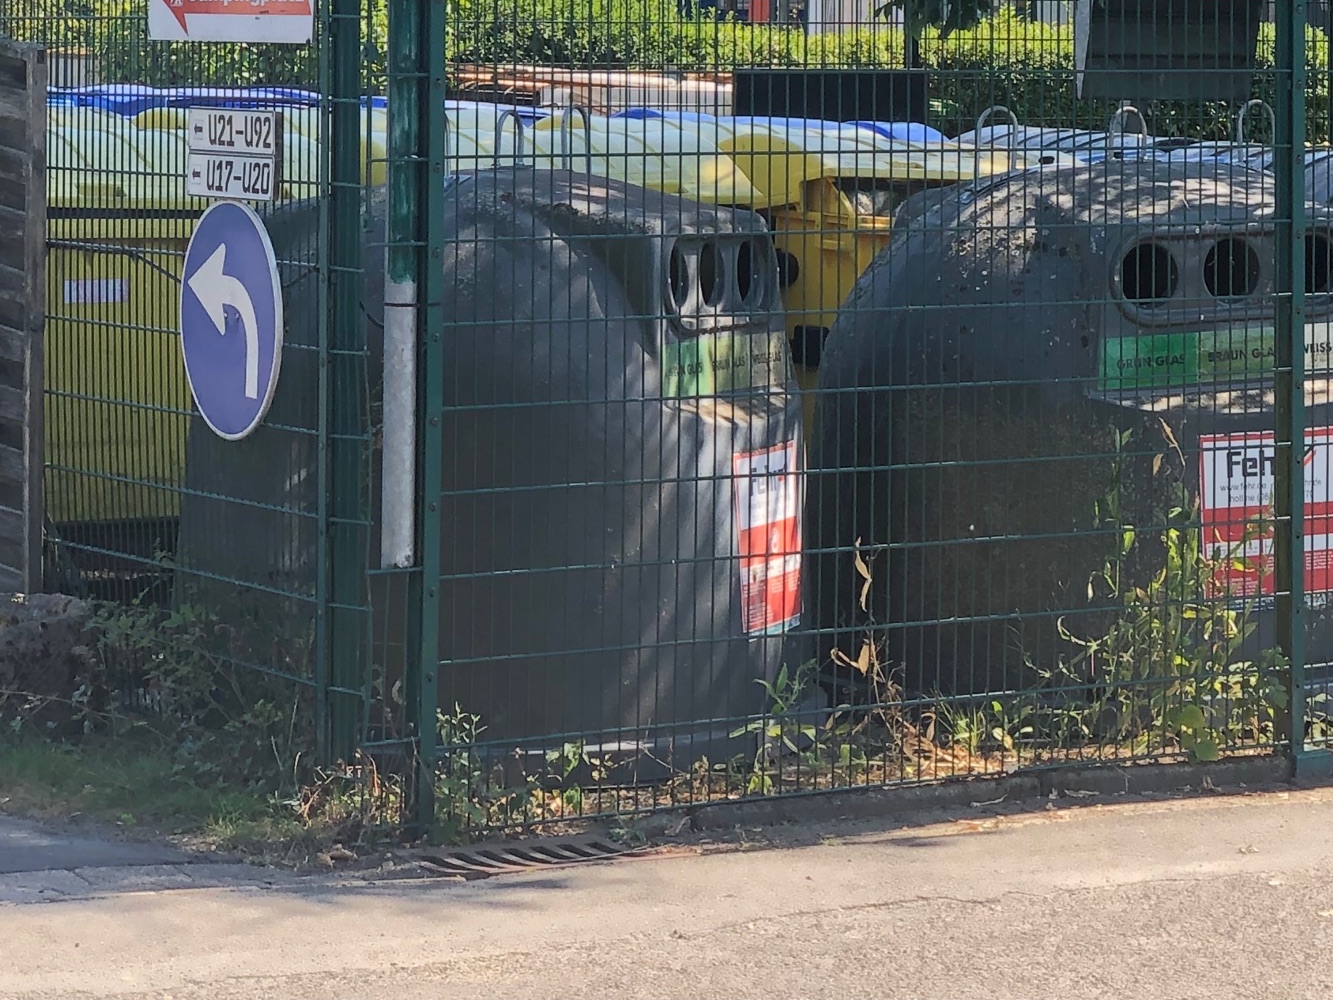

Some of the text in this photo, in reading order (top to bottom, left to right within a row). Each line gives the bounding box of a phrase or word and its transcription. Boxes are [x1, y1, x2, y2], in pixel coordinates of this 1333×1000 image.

[208, 114, 272, 149] U21-U92
[206, 159, 270, 195] U17-U20
[1156, 354, 1185, 366] GLAS
[1252, 347, 1277, 358] GLA
